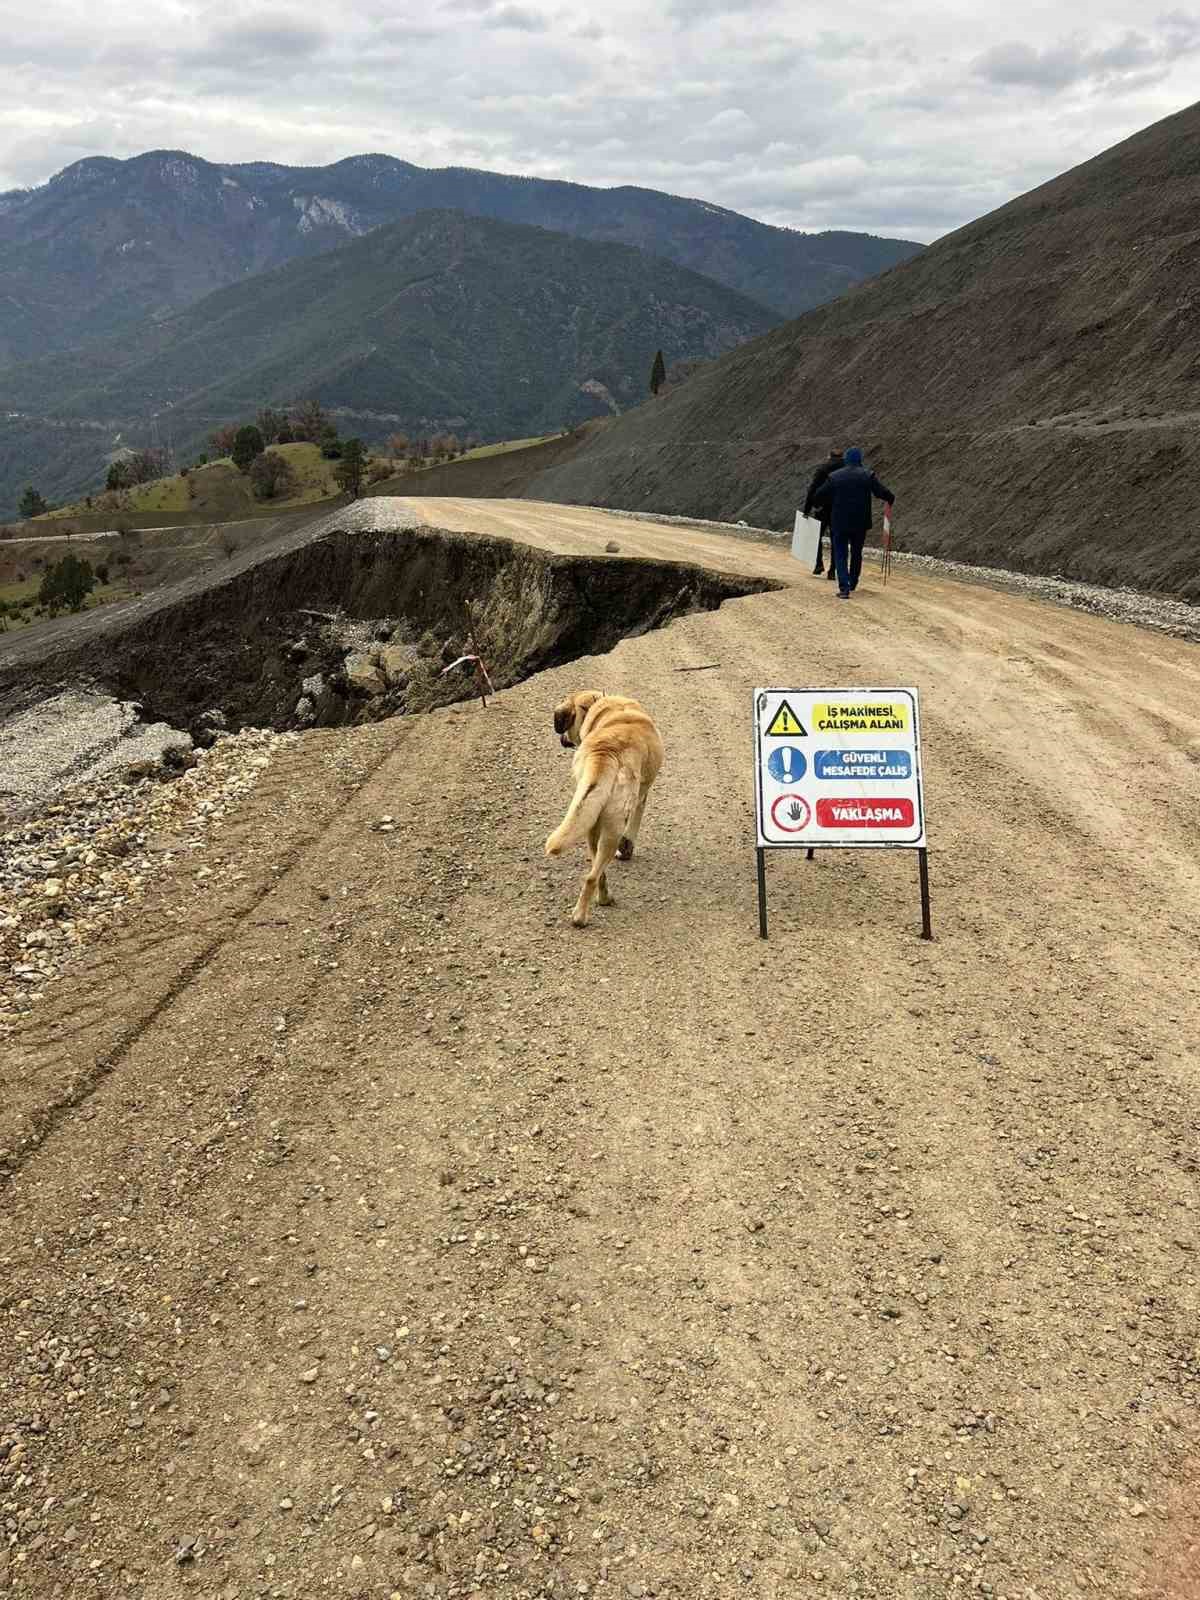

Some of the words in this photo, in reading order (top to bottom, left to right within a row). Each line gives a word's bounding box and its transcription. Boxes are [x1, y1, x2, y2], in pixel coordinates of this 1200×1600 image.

[828, 706, 838, 718] İŞ
[840, 706, 893, 716] MAKİNESİ
[818, 720, 868, 730] ÇALIŞMA
[869, 720, 903, 729] ALANI
[842, 752, 887, 763] GÜVENLİ
[823, 766, 877, 776] MESAFEDE
[878, 766, 907, 777] ÇALIŞ
[832, 807, 903, 822] YAKLAŞMA
